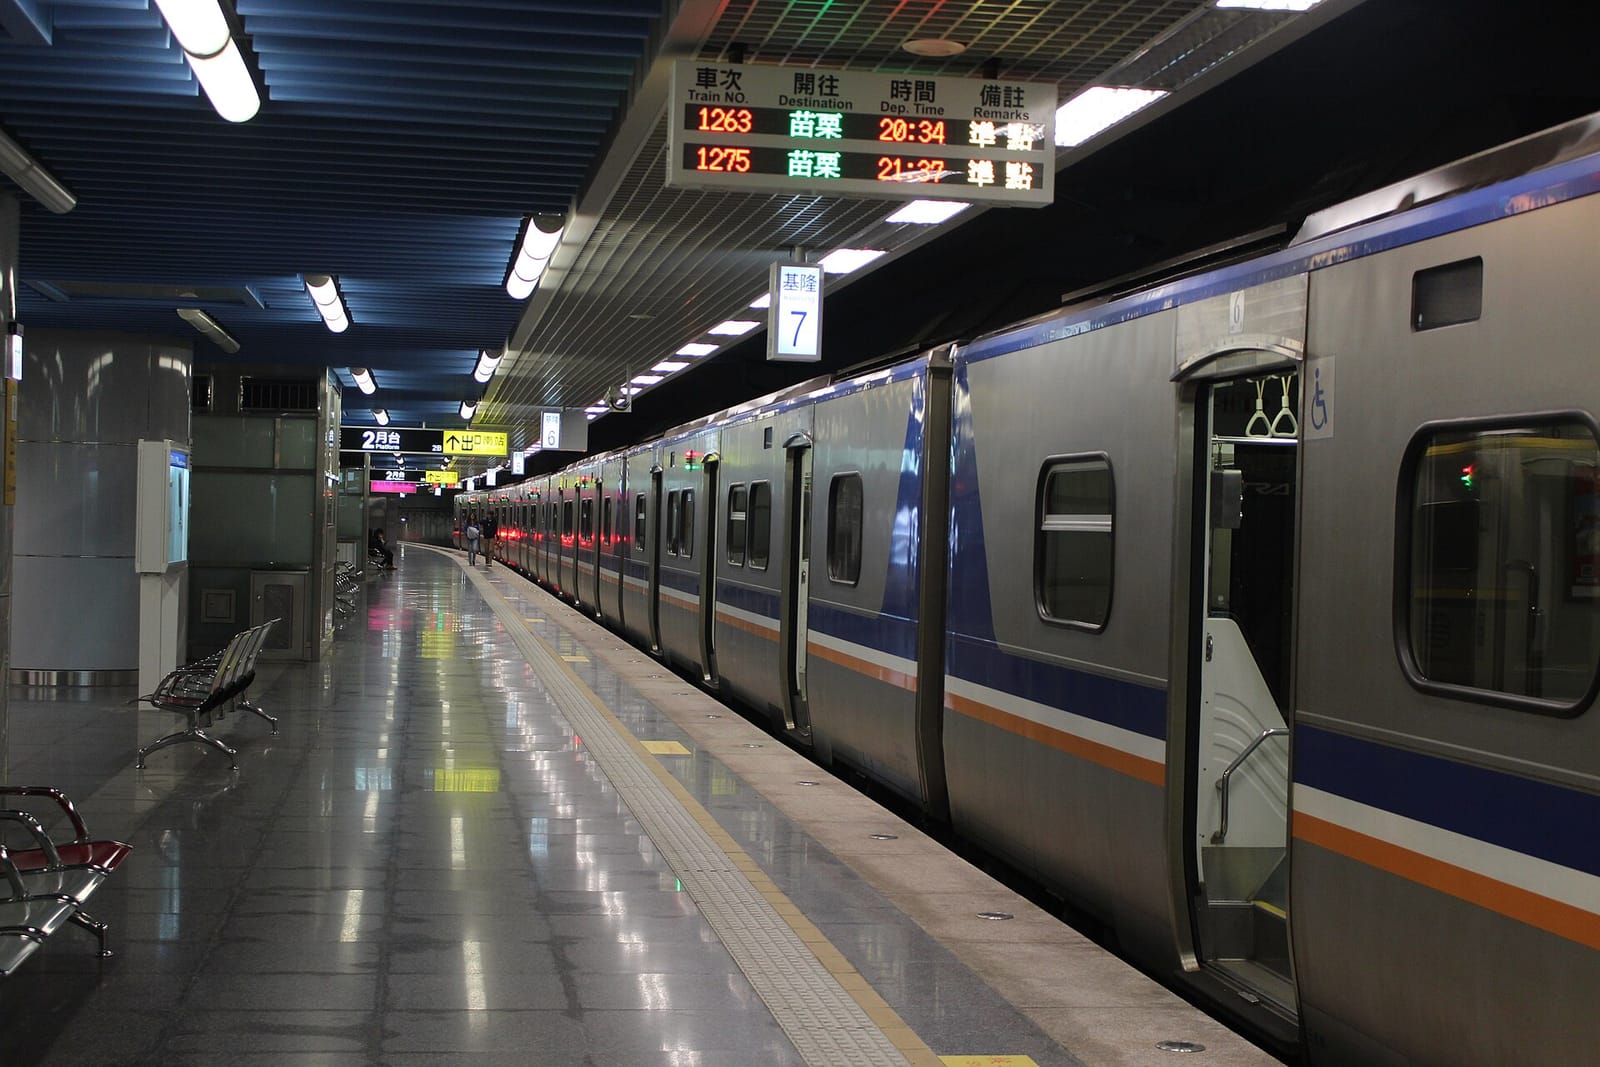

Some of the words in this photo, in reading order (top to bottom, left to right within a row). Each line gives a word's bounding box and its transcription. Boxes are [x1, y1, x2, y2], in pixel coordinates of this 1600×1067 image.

[688, 89, 721, 102] Train
[725, 92, 749, 104] NO.
[779, 94, 853, 110] Destination
[880, 101, 910, 115] Dep.
[914, 103, 945, 116] Time
[973, 106, 1030, 121] Remarks
[696, 67, 743, 90] 車次
[793, 72, 840, 97] 開往
[890, 80, 937, 103] 時間
[979, 84, 1025, 109] 備註
[698, 106, 753, 133] 1263
[788, 109, 844, 140] 苗栗
[878, 117, 946, 145] 20:34
[696, 145, 751, 173] 1275
[787, 149, 842, 179] 苗栗
[876, 156, 945, 184] 21:37
[783, 272, 817, 293] 基隆
[1233, 294, 1241, 325] 6
[790, 310, 807, 347] 7
[547, 429, 556, 447] 6
